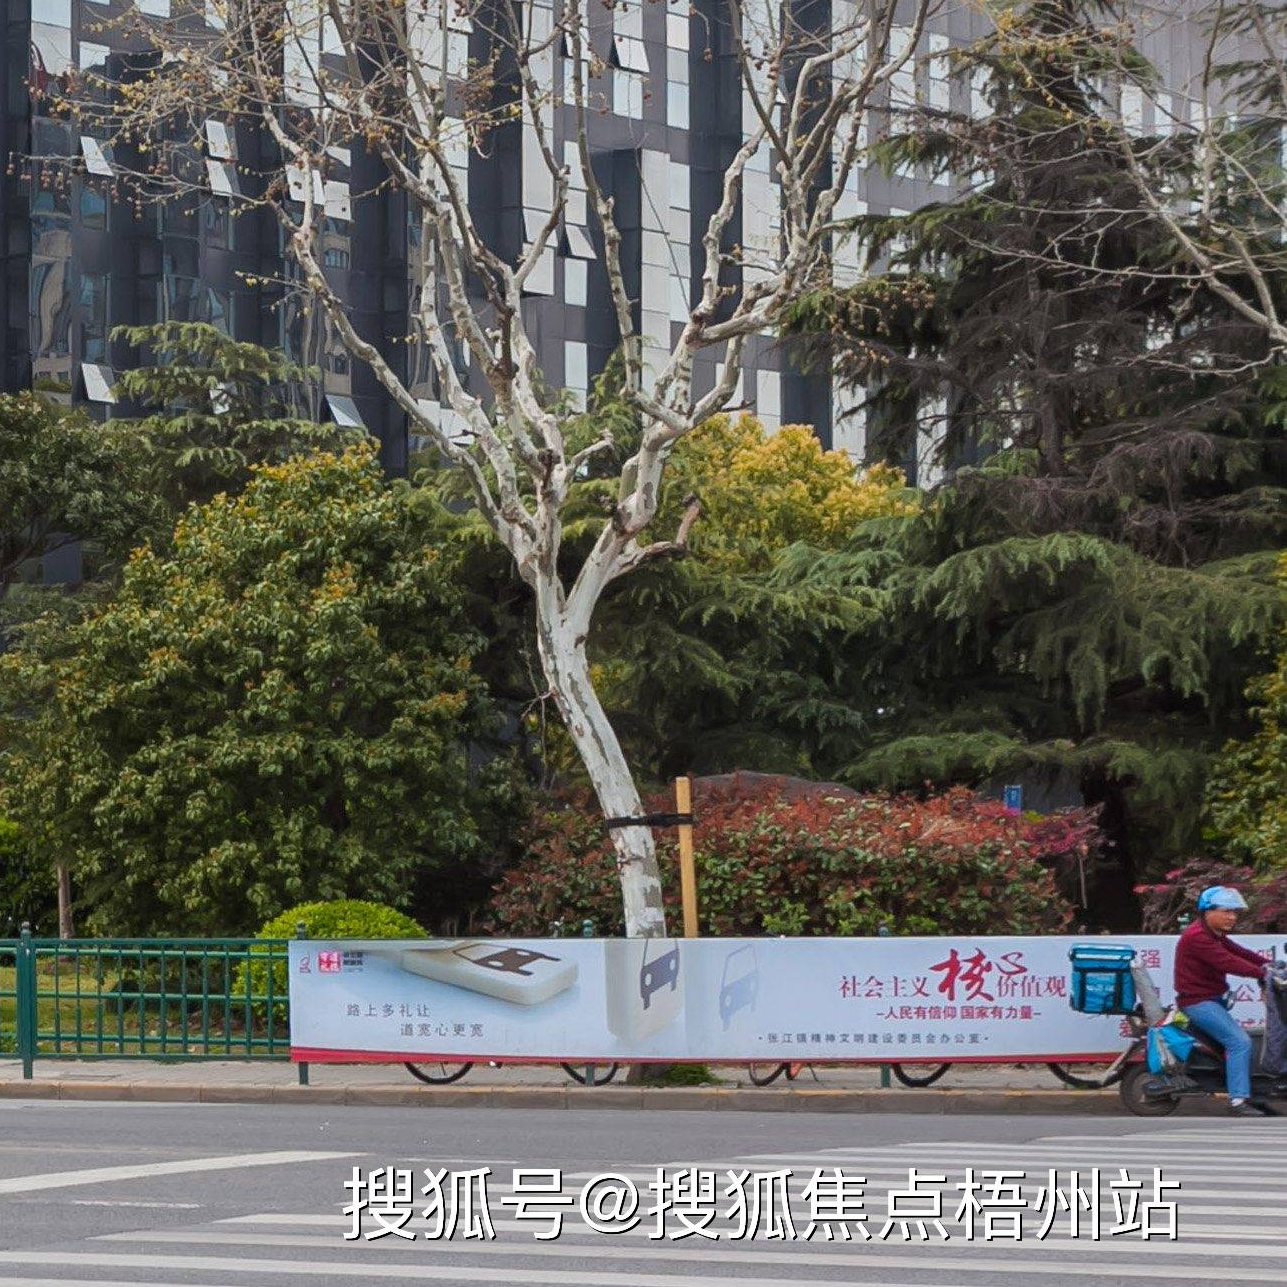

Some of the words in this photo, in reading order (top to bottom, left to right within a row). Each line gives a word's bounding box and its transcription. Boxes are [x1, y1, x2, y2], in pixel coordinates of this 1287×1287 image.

[839, 947, 1067, 1002] 社会主义核心价值观
[346, 1003, 431, 1018] 路上多礼让
[400, 1023, 484, 1037] 道宽心更宽
